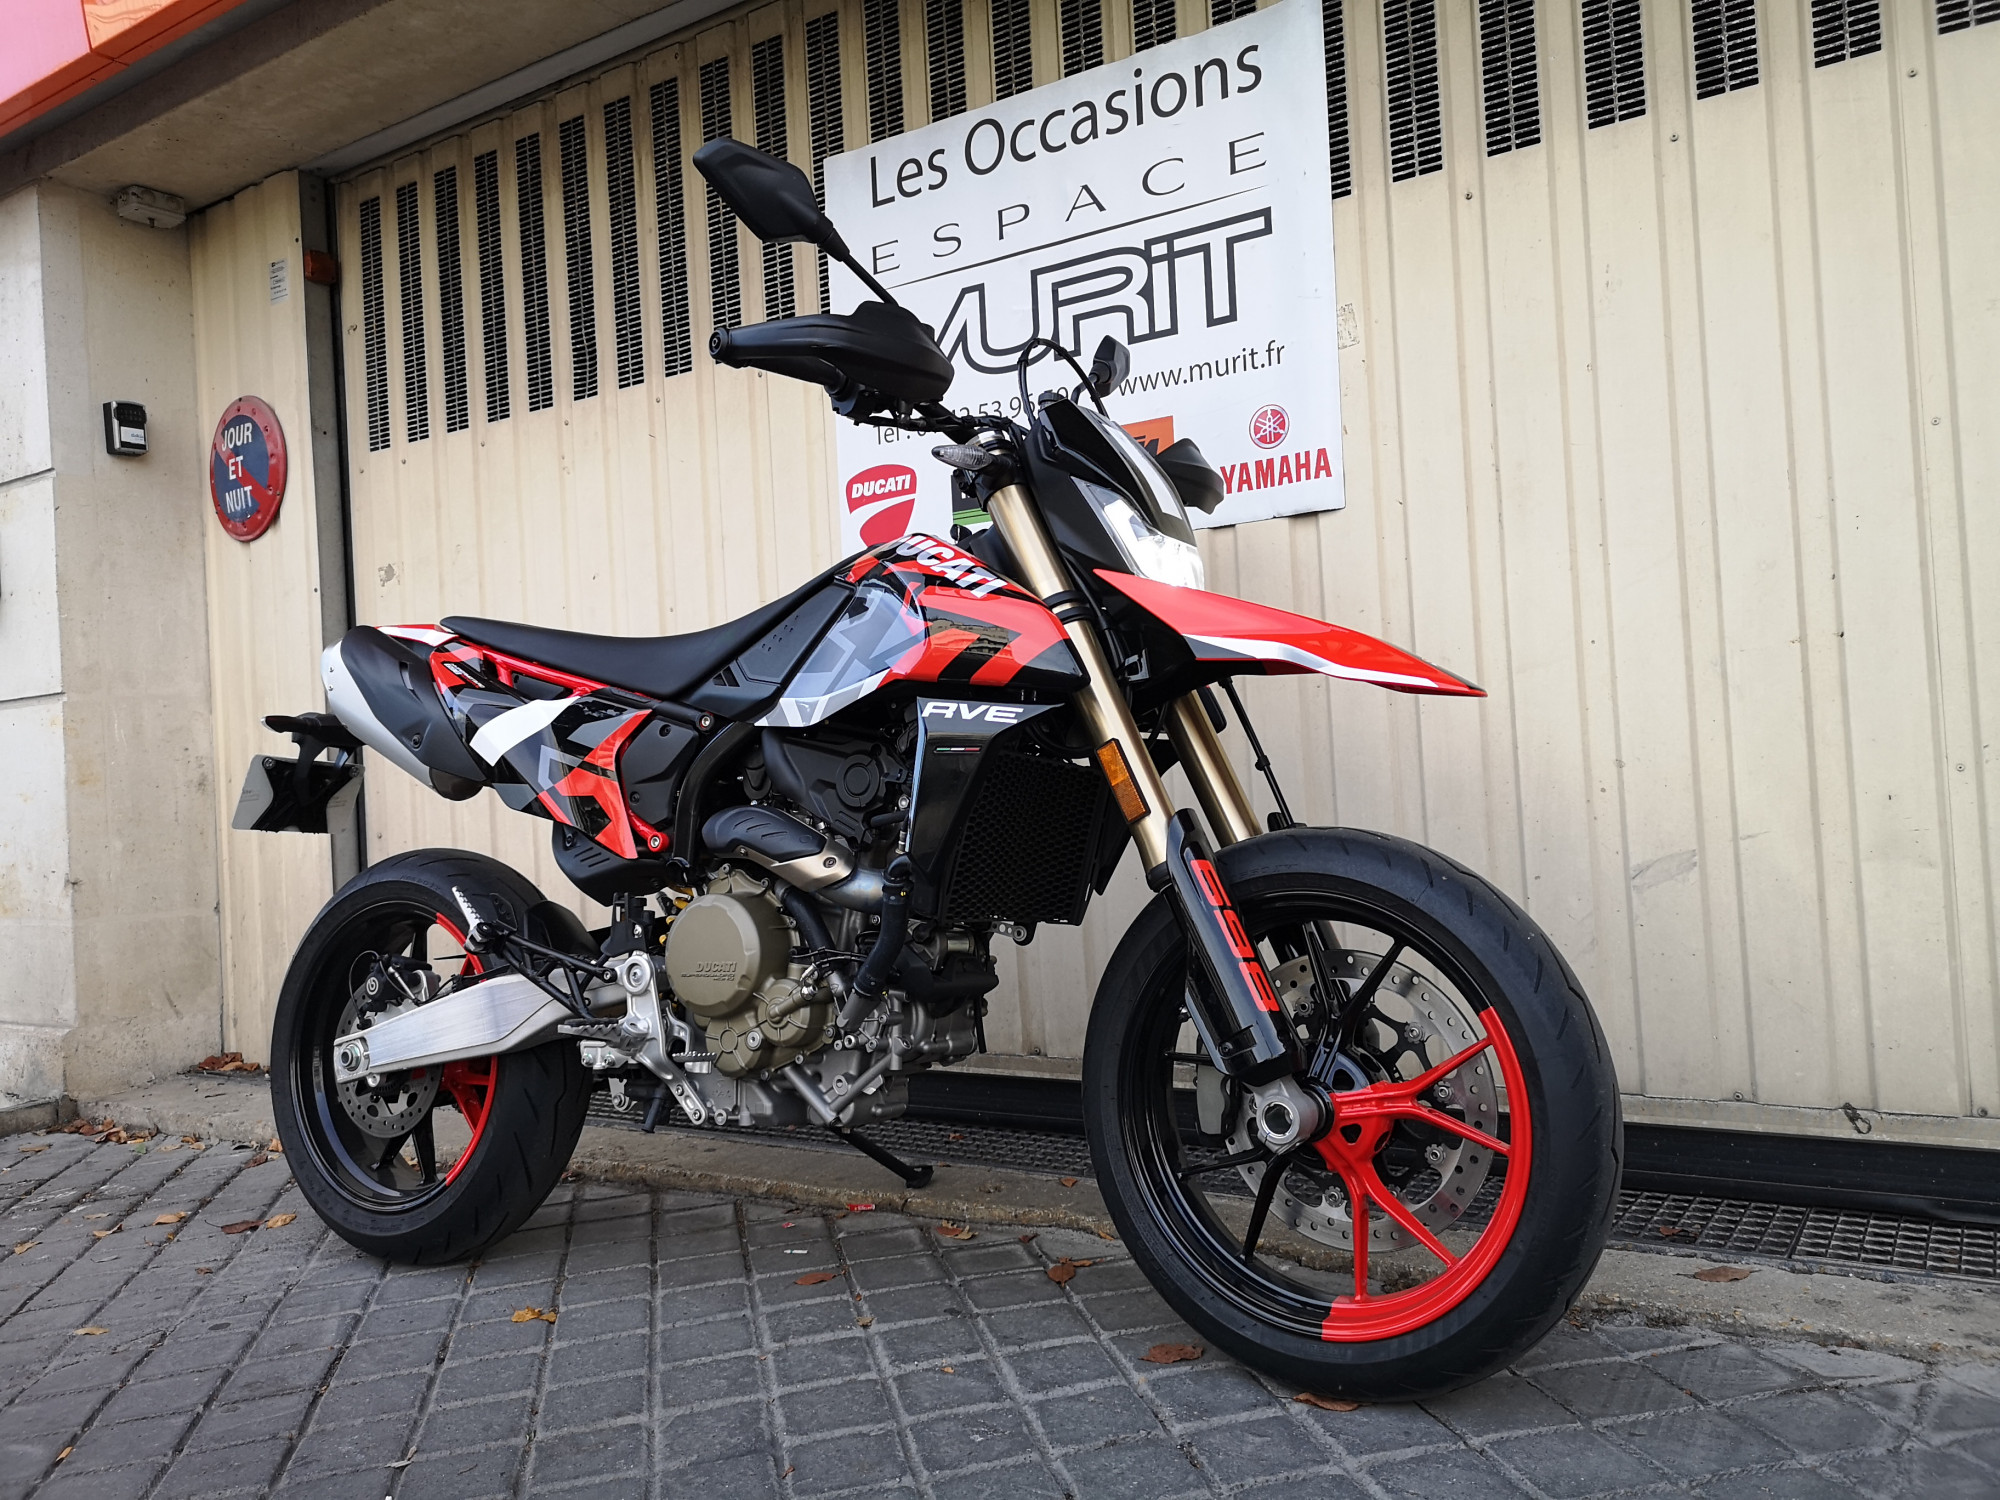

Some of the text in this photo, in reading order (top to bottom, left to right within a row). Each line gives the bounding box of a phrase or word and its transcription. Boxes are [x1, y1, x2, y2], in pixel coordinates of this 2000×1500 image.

[870, 44, 1263, 208] Les Occasions
[871, 132, 1268, 275] ESPACE
[1118, 339, 1286, 397] www.murit.fr
[221, 422, 253, 452] JOUR
[228, 455, 244, 480] ET
[851, 473, 912, 499] DUCATI
[1219, 447, 1333, 495] YAMAHA
[225, 485, 253, 514] NUIT
[889, 534, 1008, 598] UCATI
[695, 961, 738, 973] DUCATI
